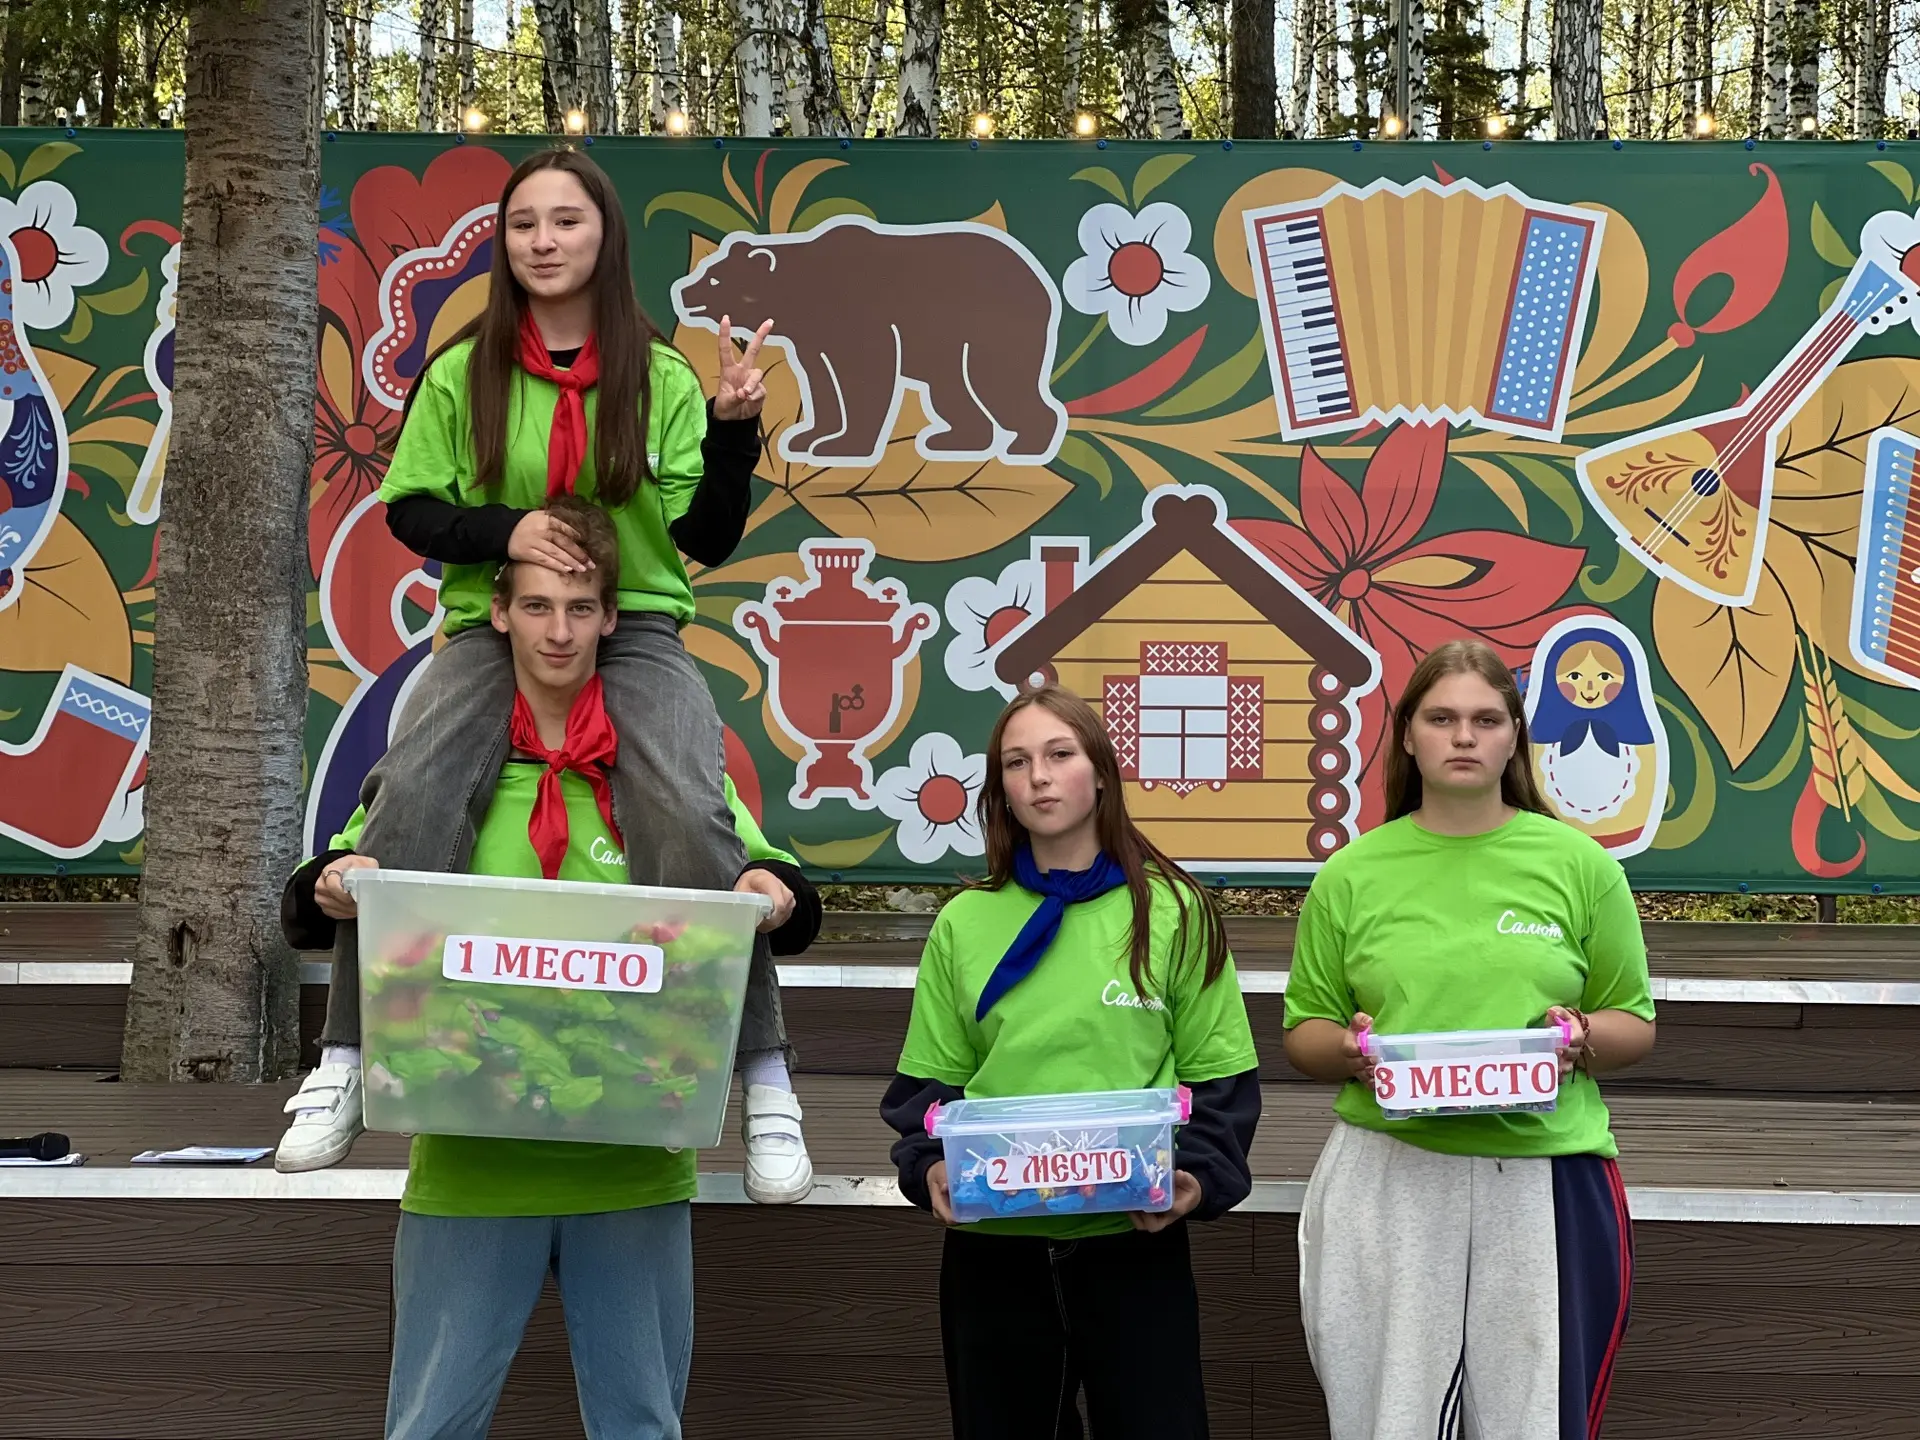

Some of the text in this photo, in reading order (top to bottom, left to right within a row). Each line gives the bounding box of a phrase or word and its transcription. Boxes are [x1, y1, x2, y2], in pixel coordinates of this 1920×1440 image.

[590, 836, 626, 865] Сал
[1497, 909, 1563, 939] Салют
[459, 940, 648, 987] 1 МЕСТО
[1375, 1061, 1557, 1100] 3 МЕСТО
[991, 1150, 1127, 1185] 2 МЕСТО
